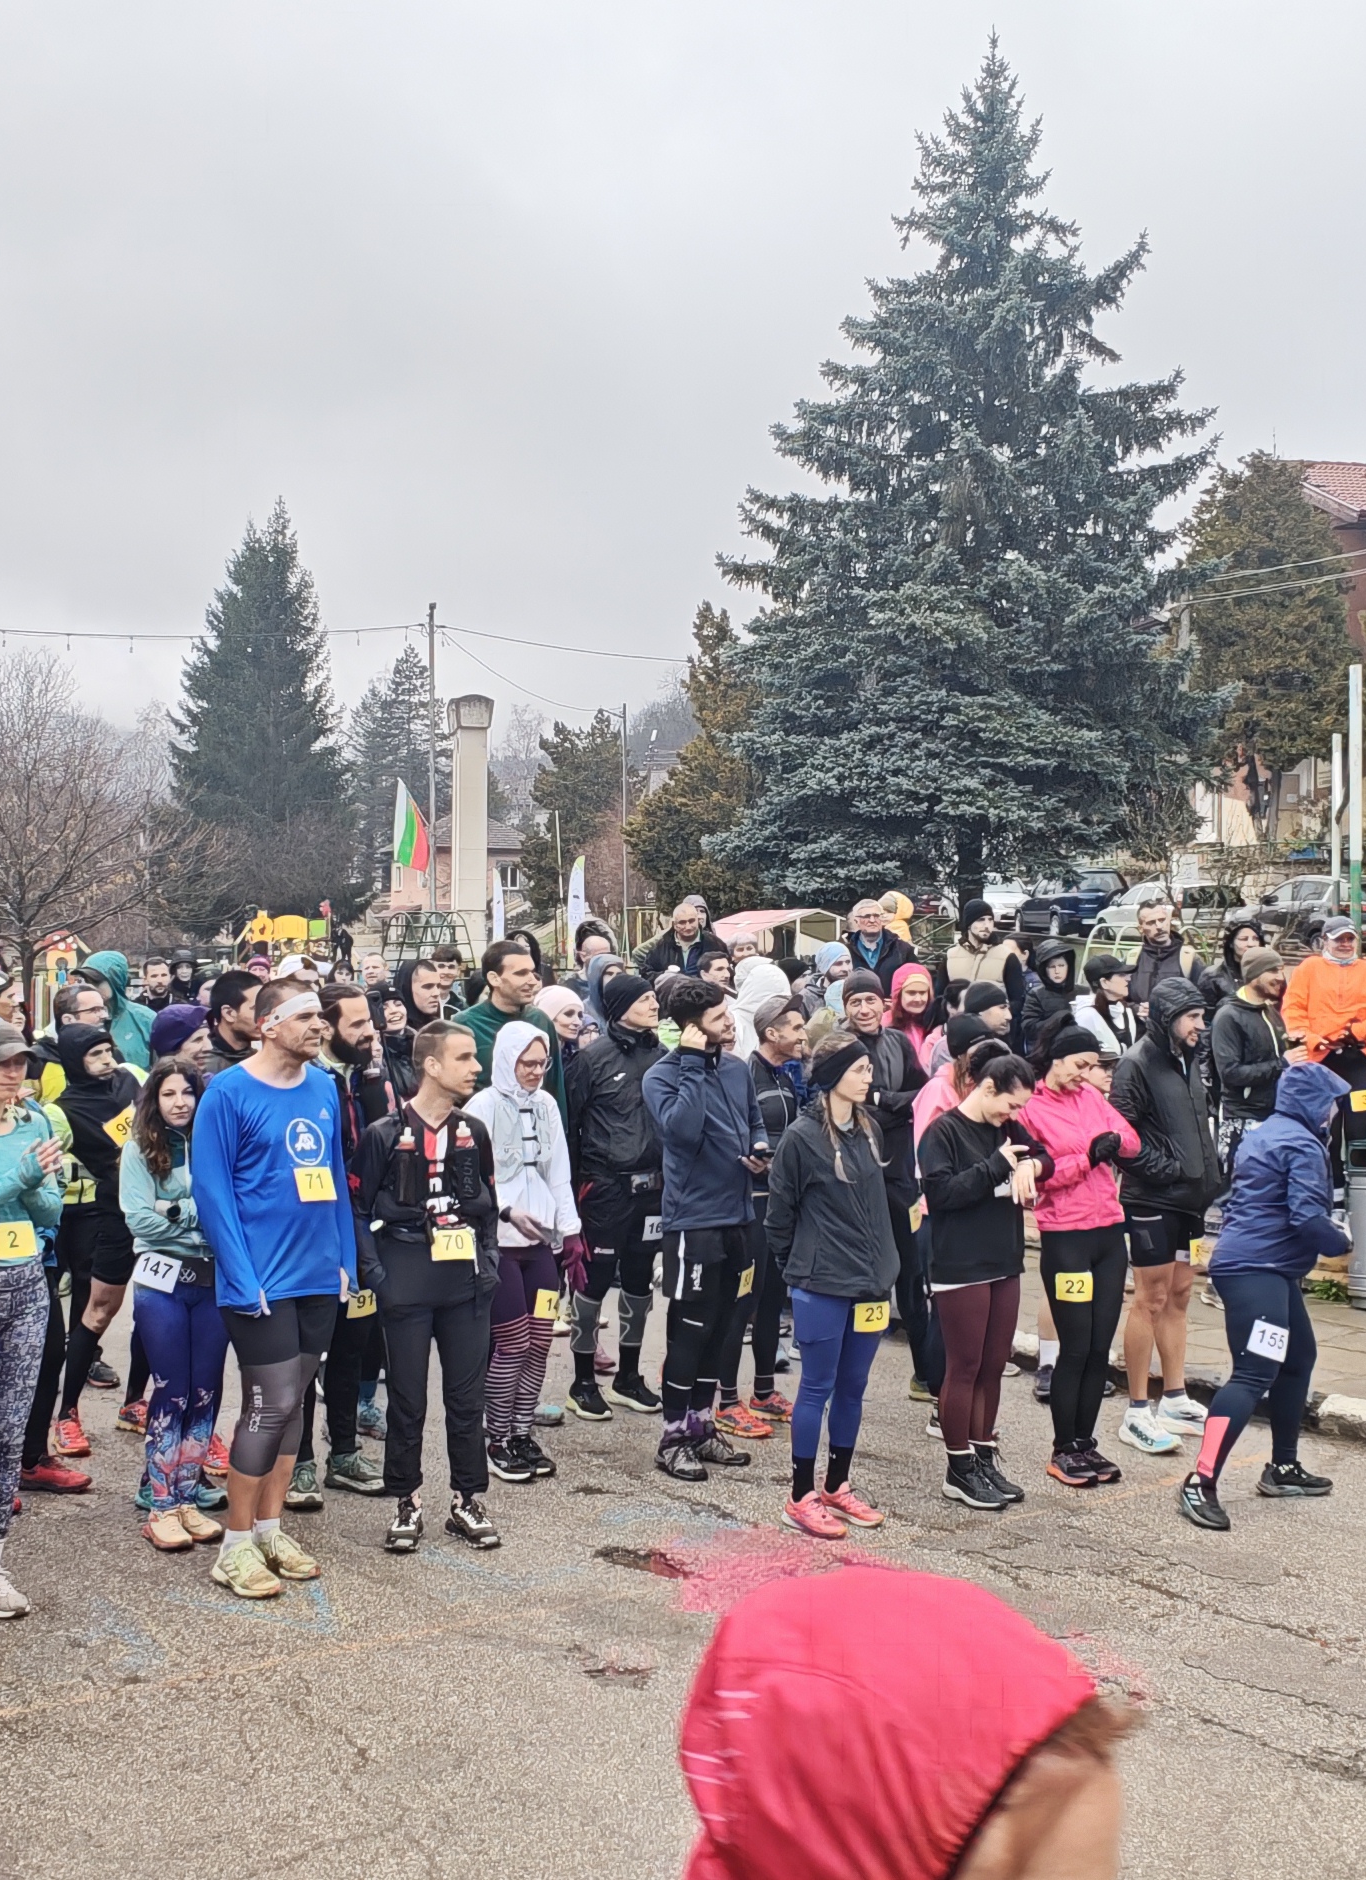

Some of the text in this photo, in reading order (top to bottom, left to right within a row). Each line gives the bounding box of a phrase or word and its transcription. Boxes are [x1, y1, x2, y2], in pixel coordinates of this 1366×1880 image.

[305, 1173, 324, 1190] 71
[7, 1230, 20, 1249] 2
[442, 1234, 464, 1251] 70
[142, 1257, 173, 1280] 147
[1065, 1280, 1085, 1294] 22
[357, 1293, 373, 1309] 91
[865, 1305, 883, 1323] 23
[1258, 1329, 1284, 1350] 155
